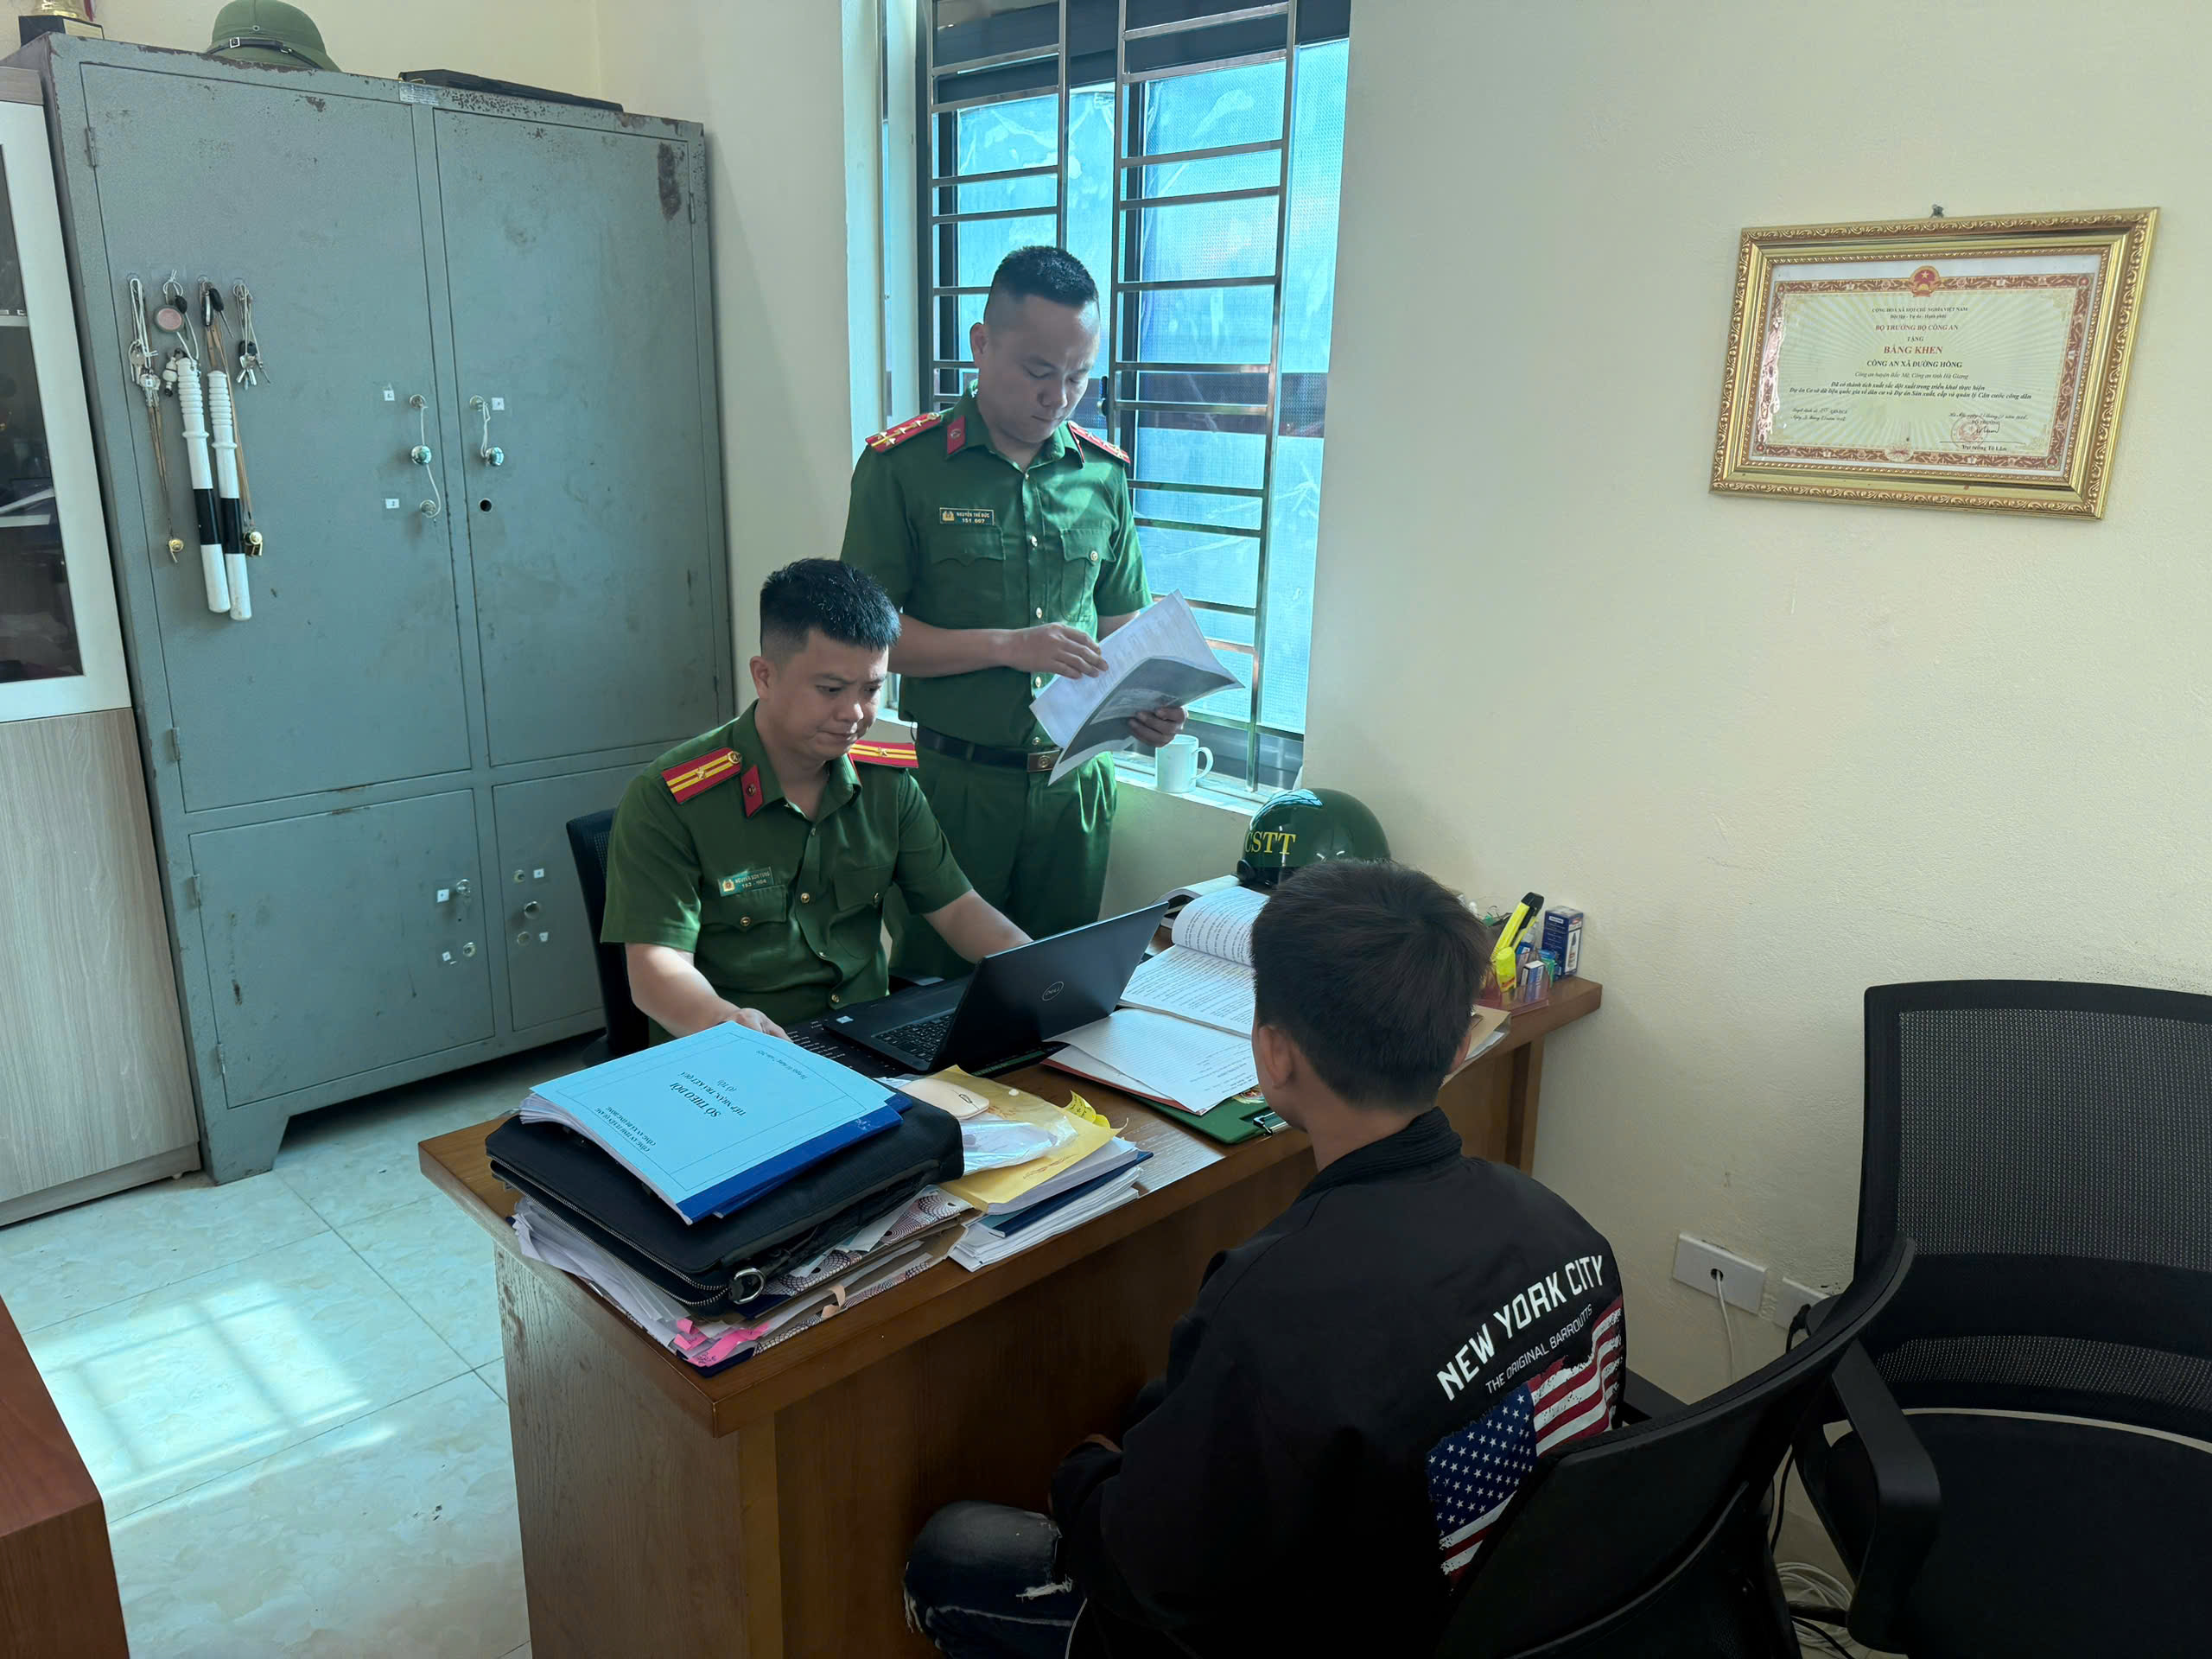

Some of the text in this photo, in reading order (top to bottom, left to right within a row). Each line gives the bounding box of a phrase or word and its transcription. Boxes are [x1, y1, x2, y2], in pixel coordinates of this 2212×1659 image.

[1245, 831, 1296, 855] CSTT
[683, 1091, 710, 1109] THEO
[703, 1107, 721, 1117] SỔ
[1436, 1255, 1603, 1402] NEW YORK CITY
[1485, 1373, 1505, 1394] THE
[1506, 1344, 1549, 1379] ORIGINAL
